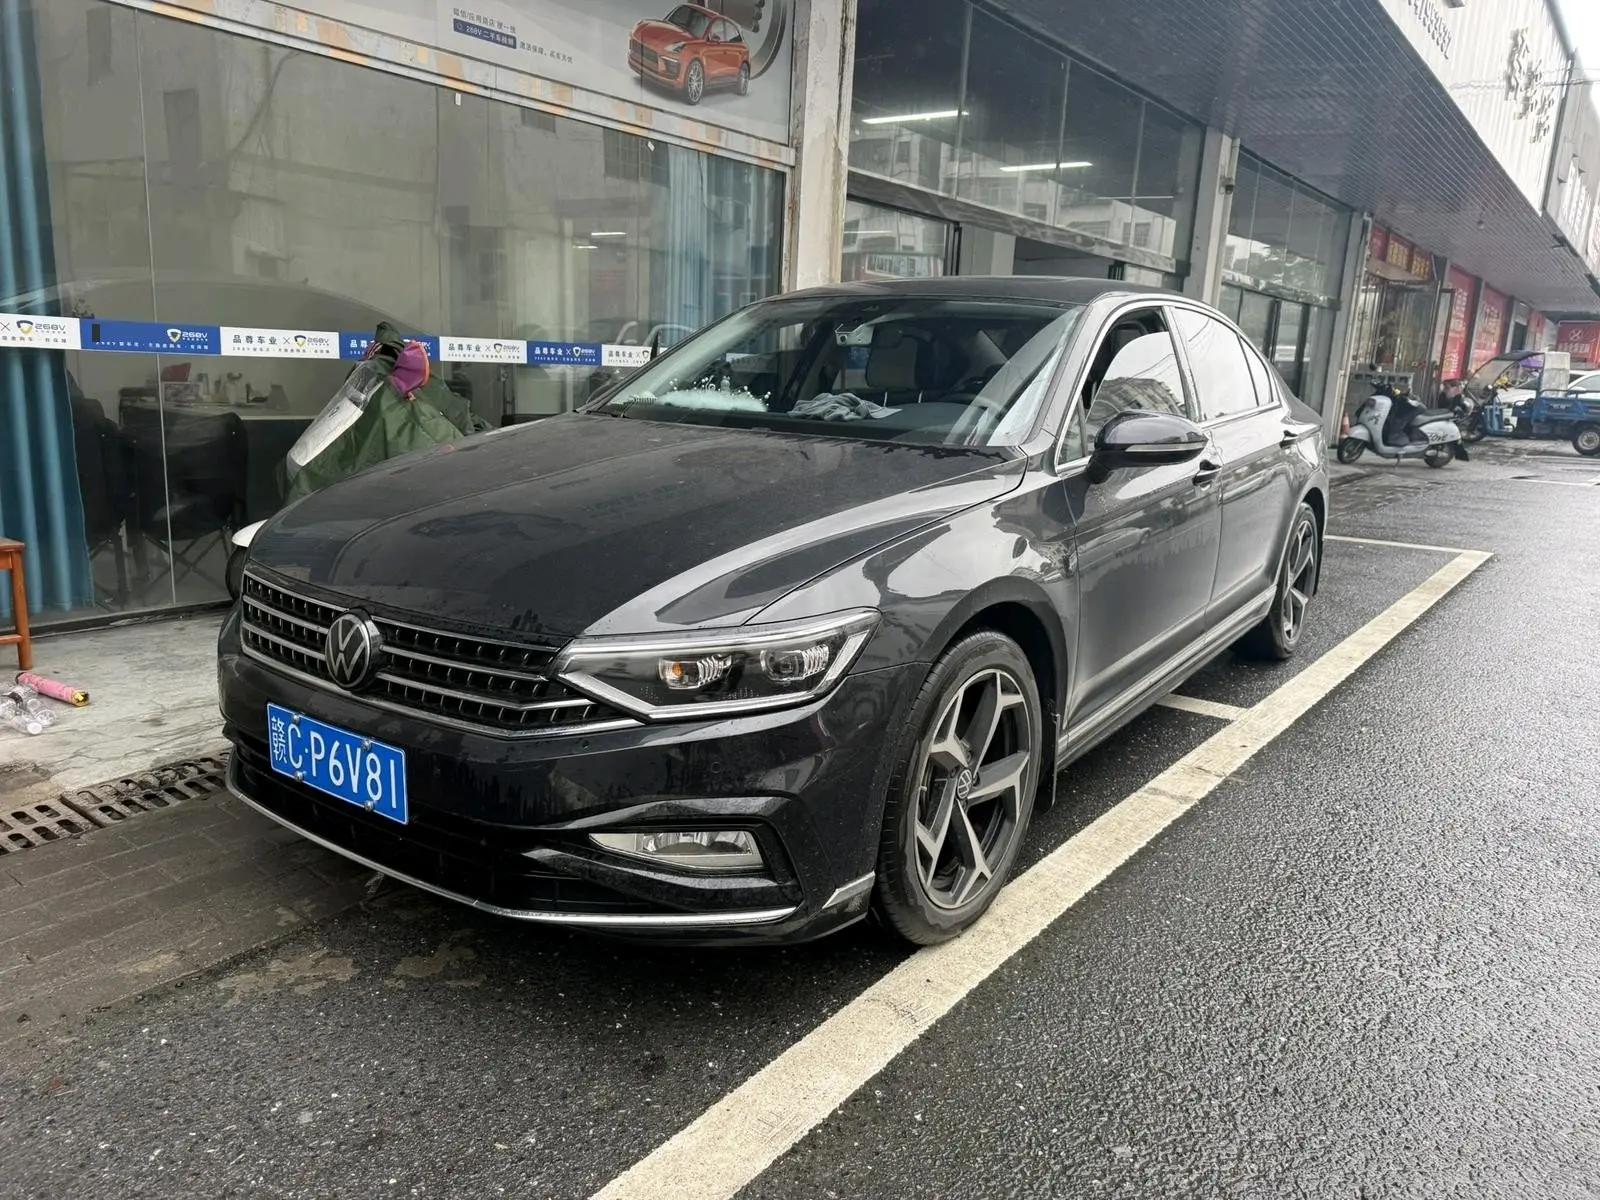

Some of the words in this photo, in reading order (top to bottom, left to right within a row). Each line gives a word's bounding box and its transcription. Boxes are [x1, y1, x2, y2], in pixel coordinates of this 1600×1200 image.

[34, 323, 66, 331] 268V
[233, 334, 277, 345] 品尊车业
